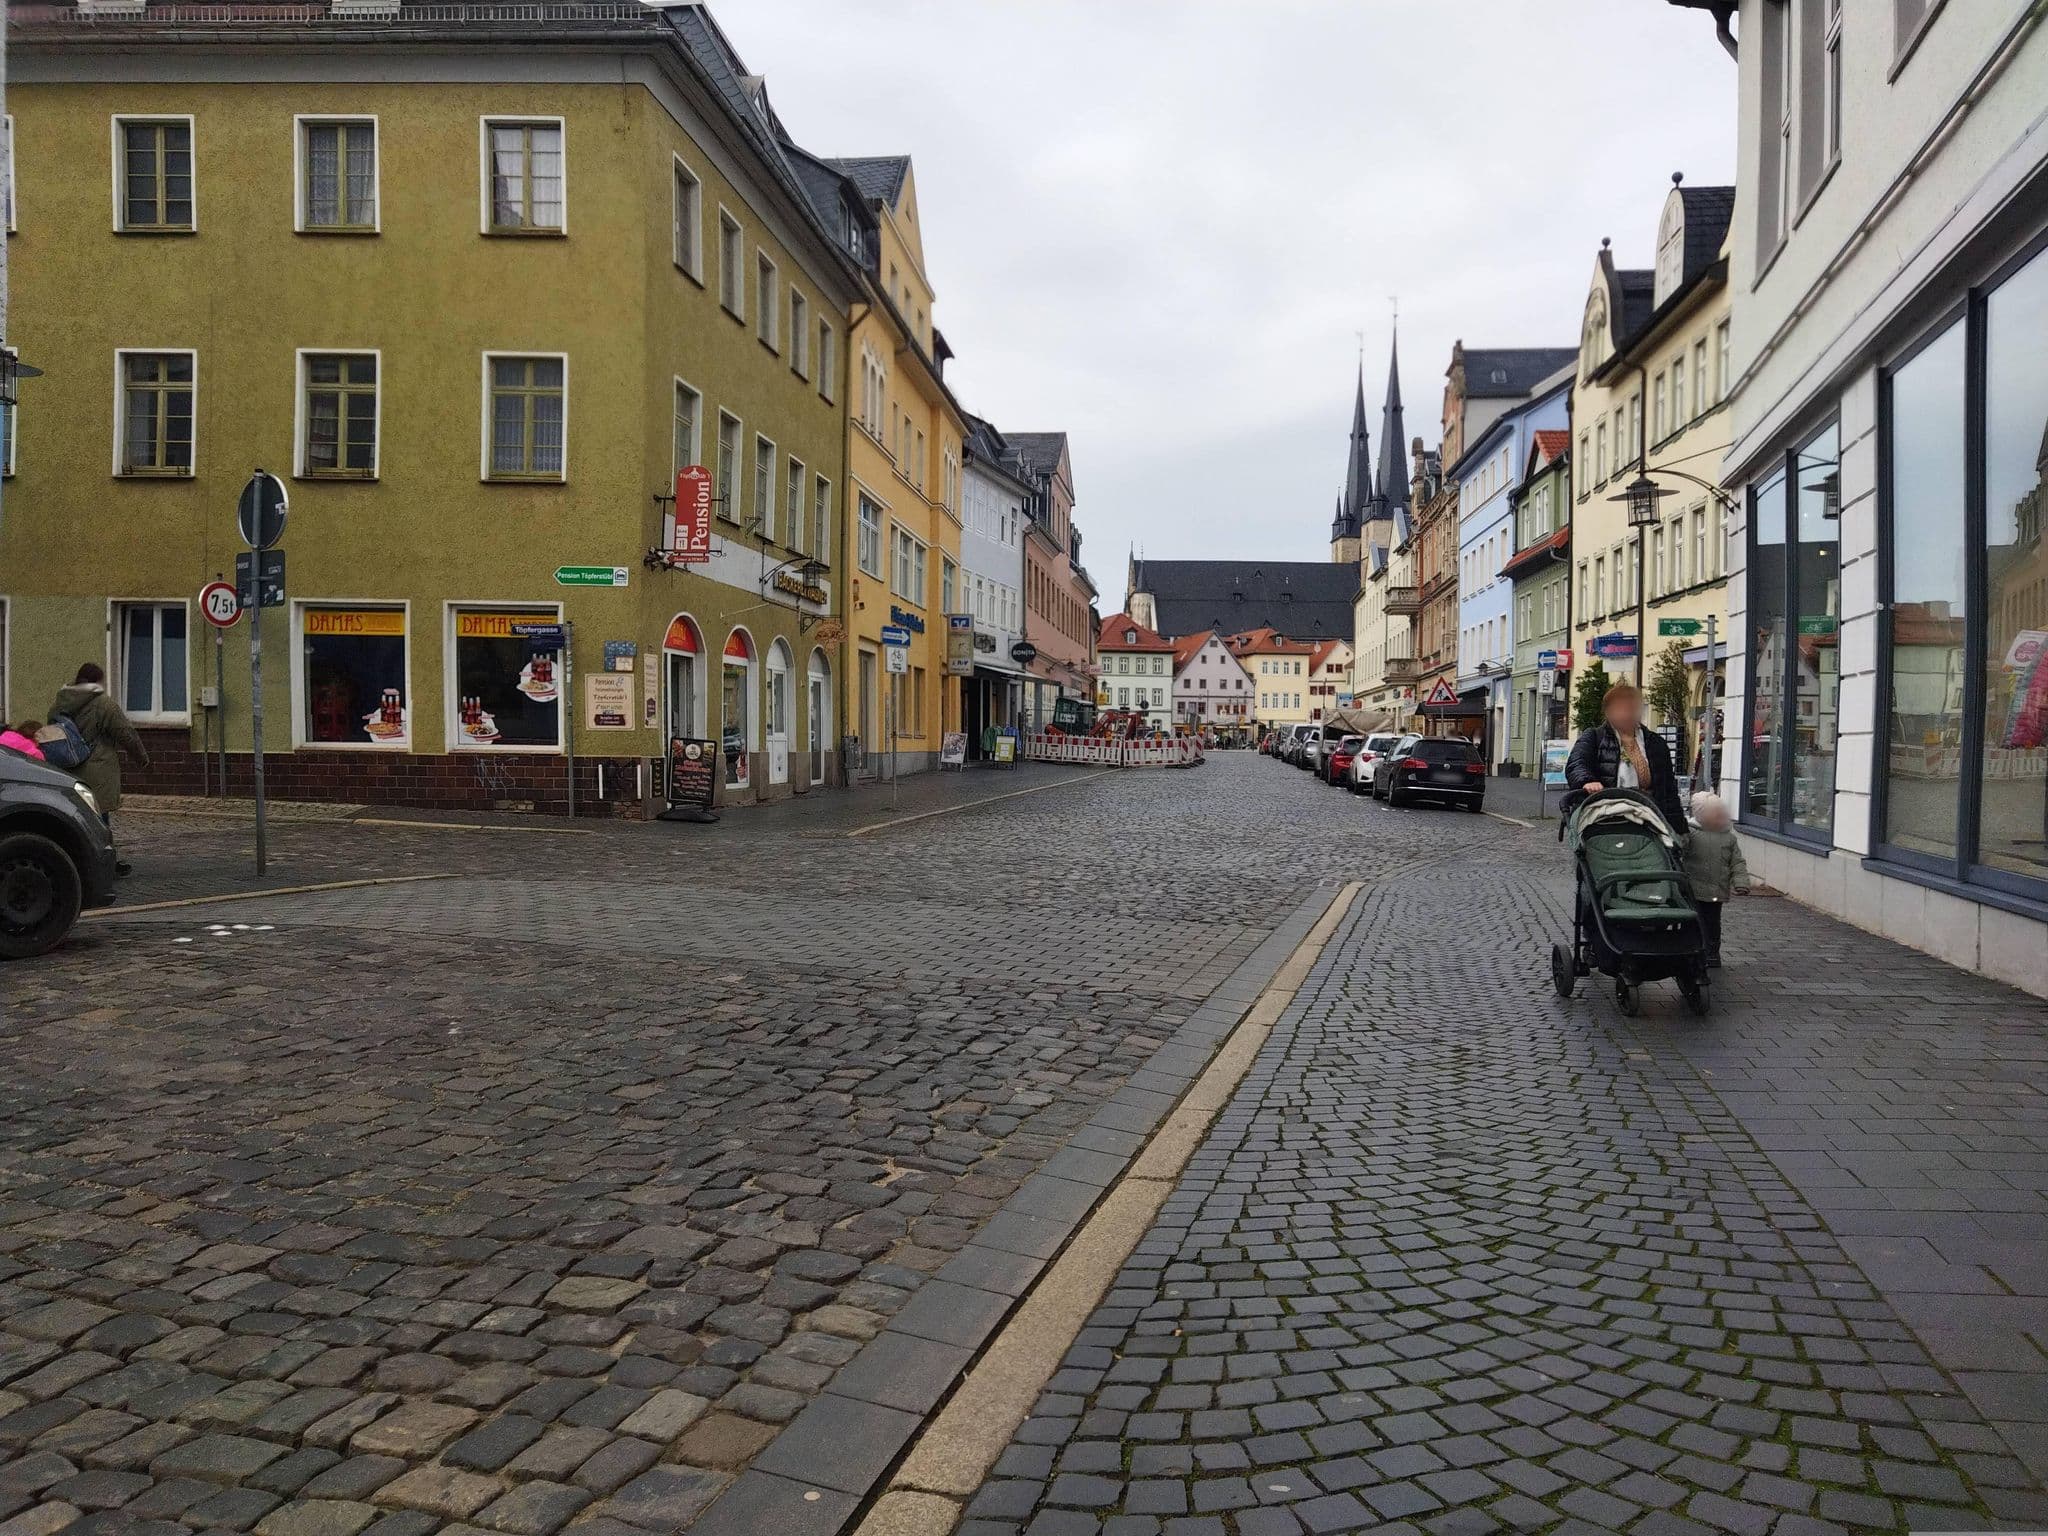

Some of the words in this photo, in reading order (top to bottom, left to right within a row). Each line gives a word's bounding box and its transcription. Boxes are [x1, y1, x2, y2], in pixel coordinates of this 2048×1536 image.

[691, 481, 710, 550] Pension
[309, 614, 363, 632] DAMAS
[515, 626, 558, 635] Töpfergasse
